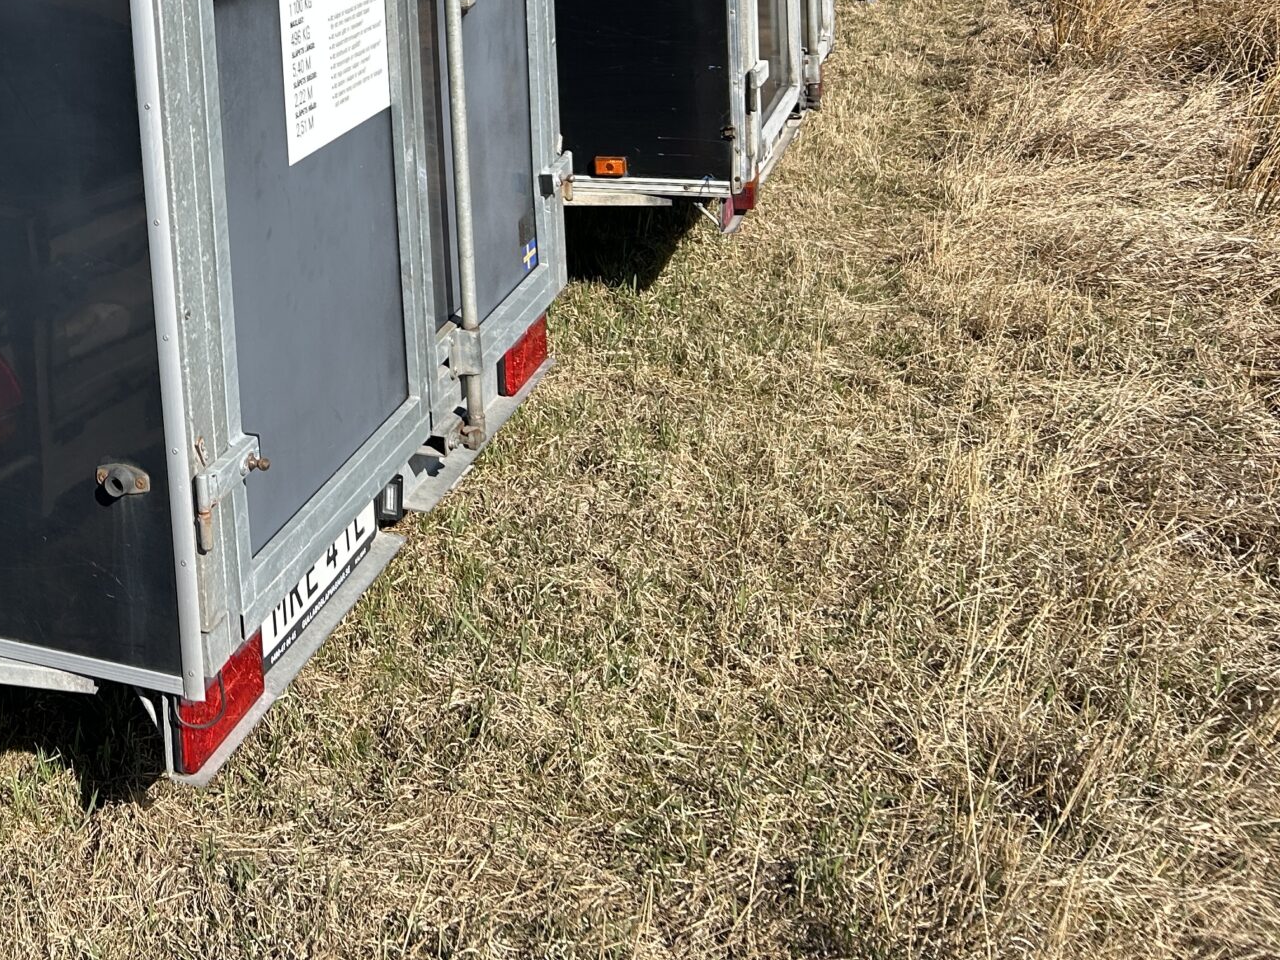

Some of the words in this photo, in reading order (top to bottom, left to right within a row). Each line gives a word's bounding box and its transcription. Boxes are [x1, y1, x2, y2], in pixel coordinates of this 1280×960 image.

[302, 24, 311, 41] KG
[305, 55, 312, 70] M
[307, 85, 314, 100] M
[308, 115, 315, 130] M
